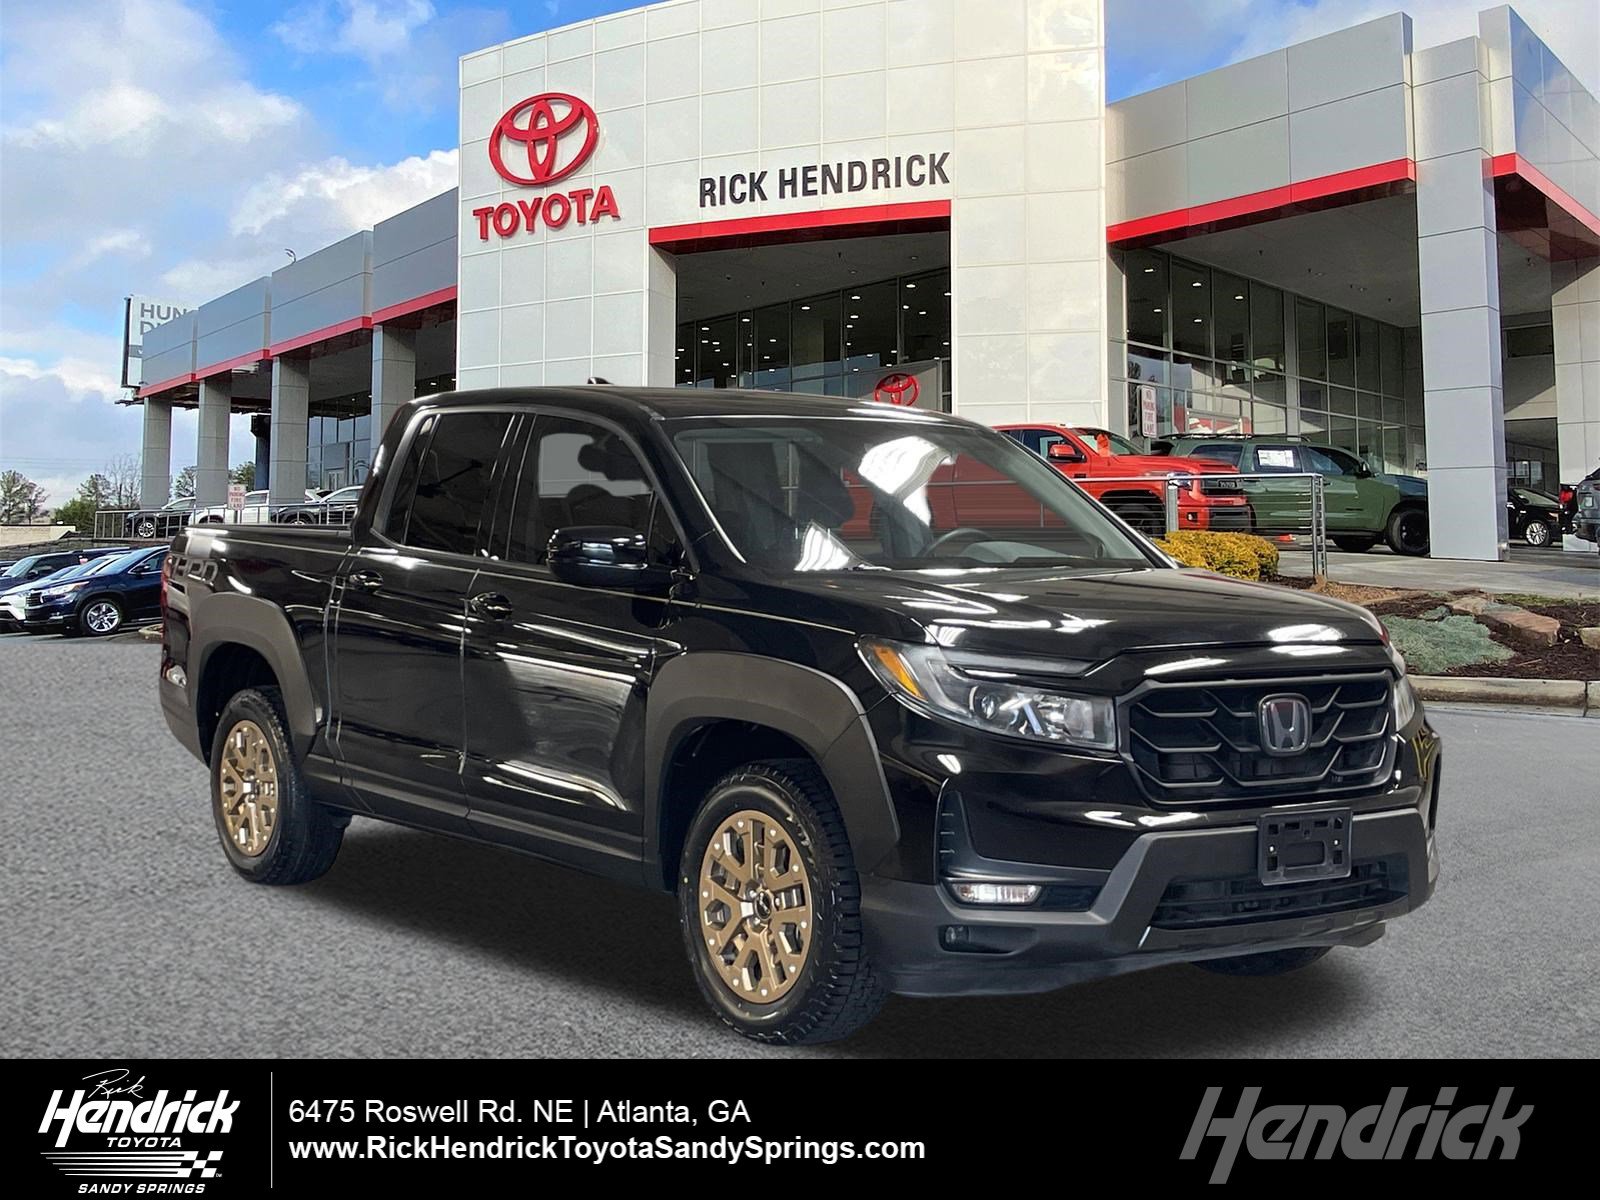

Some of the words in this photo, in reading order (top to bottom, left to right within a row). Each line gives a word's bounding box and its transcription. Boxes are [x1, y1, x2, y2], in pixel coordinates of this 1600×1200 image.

[699, 170, 768, 208] RICK
[779, 151, 951, 200] HENDRICK
[473, 185, 621, 240] TOYOTA
